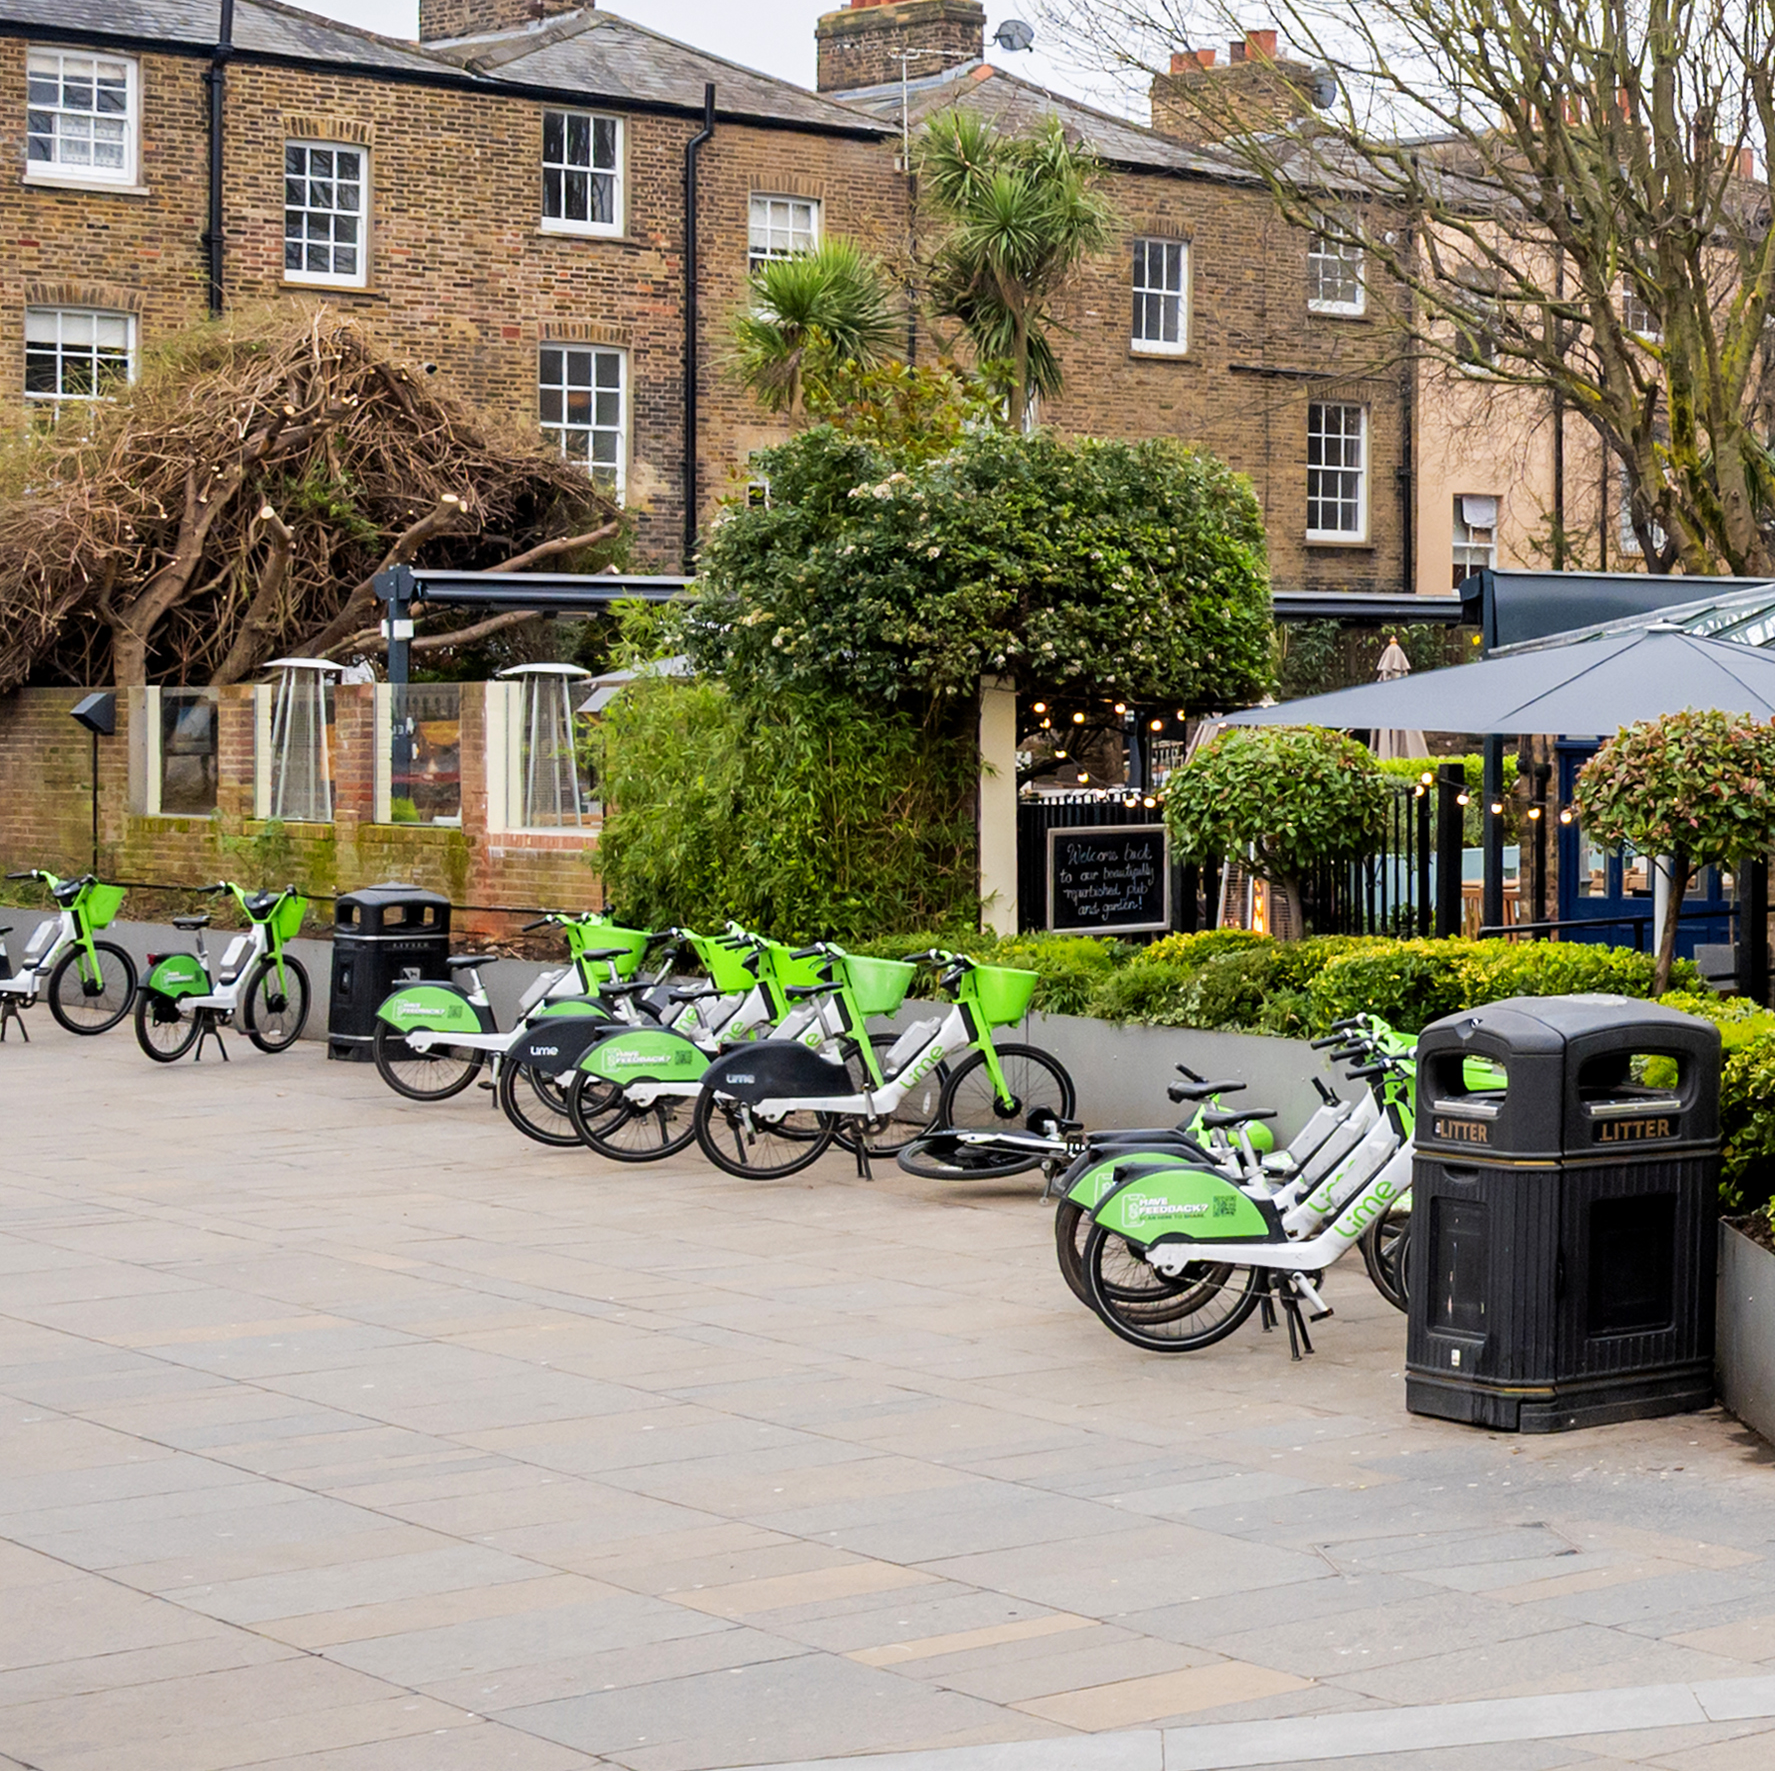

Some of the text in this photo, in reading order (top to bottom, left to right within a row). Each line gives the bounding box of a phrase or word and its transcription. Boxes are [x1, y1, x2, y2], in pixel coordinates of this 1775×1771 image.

[1067, 842, 1153, 865] Welcome back
[1059, 862, 1155, 886] to our beautifully
[1125, 881, 1149, 901] pub
[1078, 895, 1143, 921] and garden!
[900, 1044, 945, 1090] Lime
[1439, 1119, 1488, 1143] LITTER
[1600, 1118, 1670, 1142] LITTER
[1139, 1196, 1168, 1207] HAVE
[1139, 1203, 1209, 1215] FEEDBACK?
[1333, 1180, 1397, 1238] Lime
